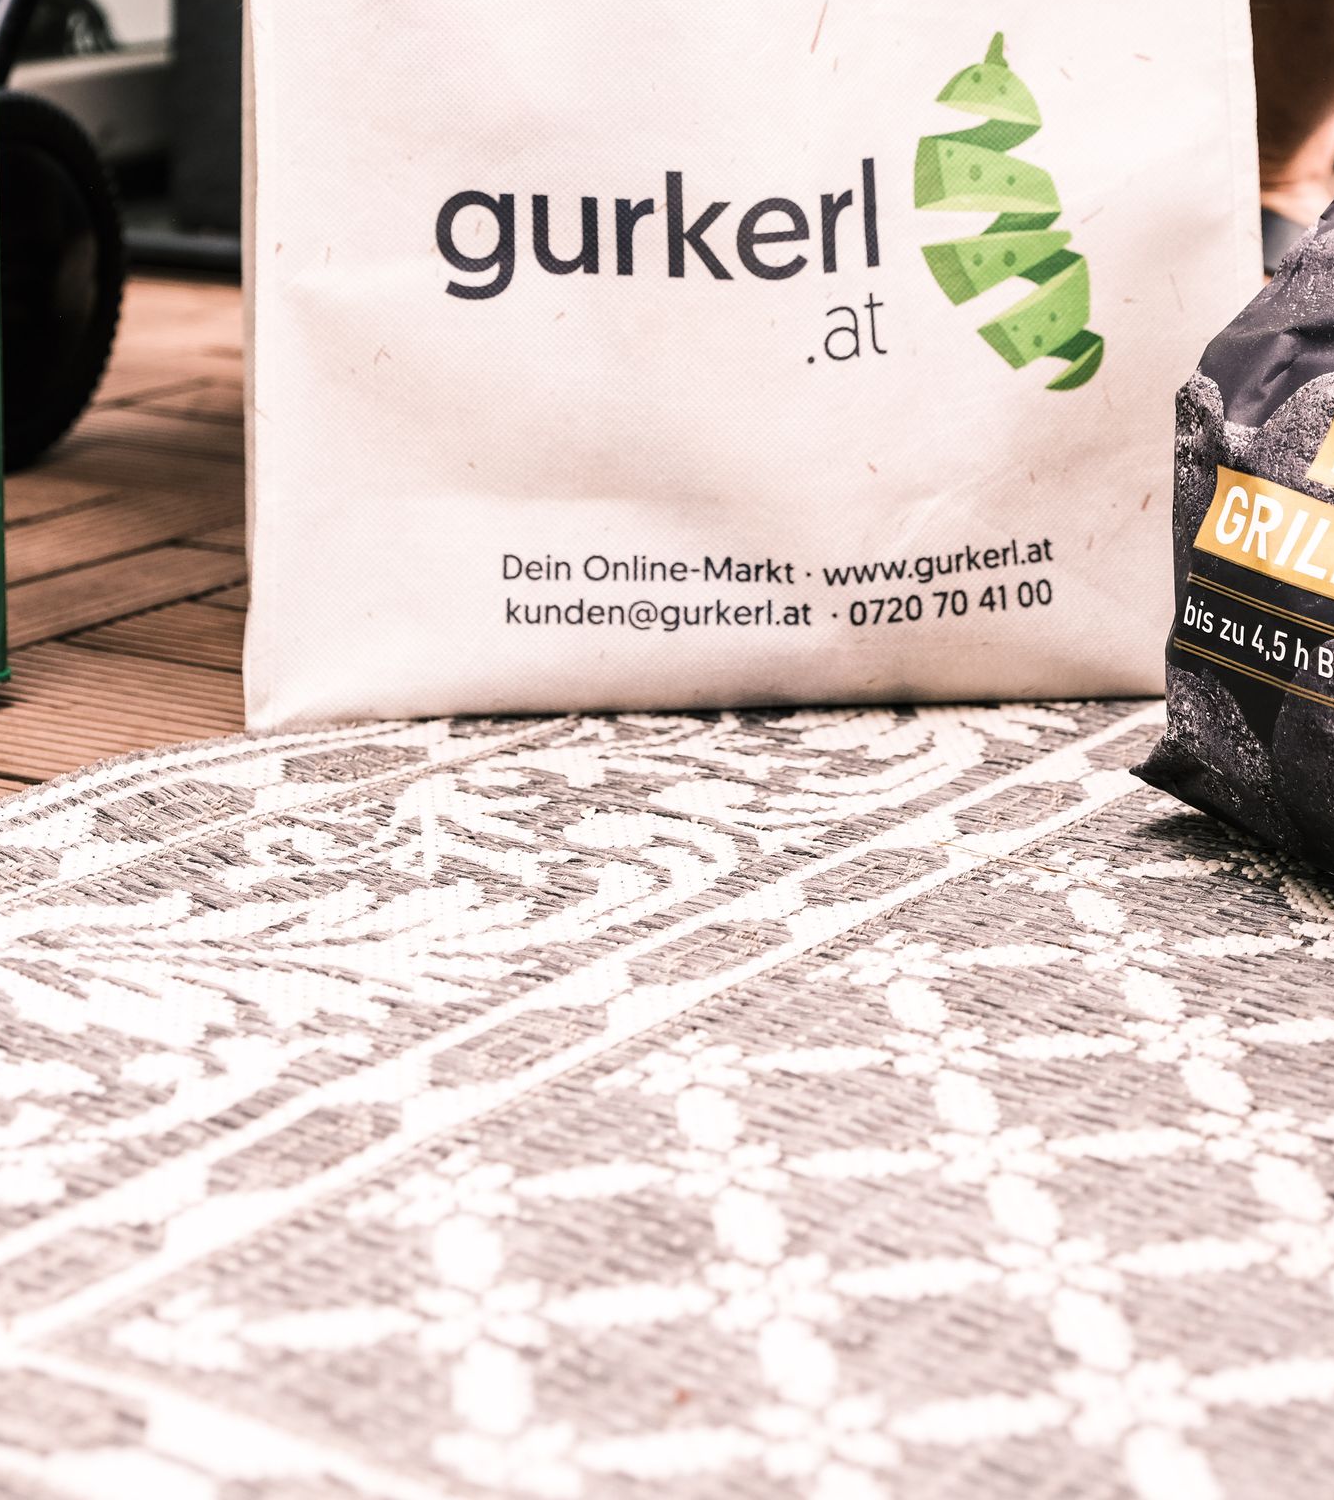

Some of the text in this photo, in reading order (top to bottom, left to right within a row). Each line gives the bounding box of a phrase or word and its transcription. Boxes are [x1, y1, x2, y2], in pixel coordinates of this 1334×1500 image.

[434, 157, 882, 300] gurkerl
[806, 291, 888, 363] .at
[502, 537, 1053, 587] Dein Online-Markt www.gurkerl.at
[505, 579, 1053, 631] kunden@gurkerl.at 0720 70 41 00
[1181, 594, 1216, 635] bis
[1219, 612, 1247, 648] zu
[1250, 622, 1288, 666] 4,5
[1293, 635, 1312, 672] h
